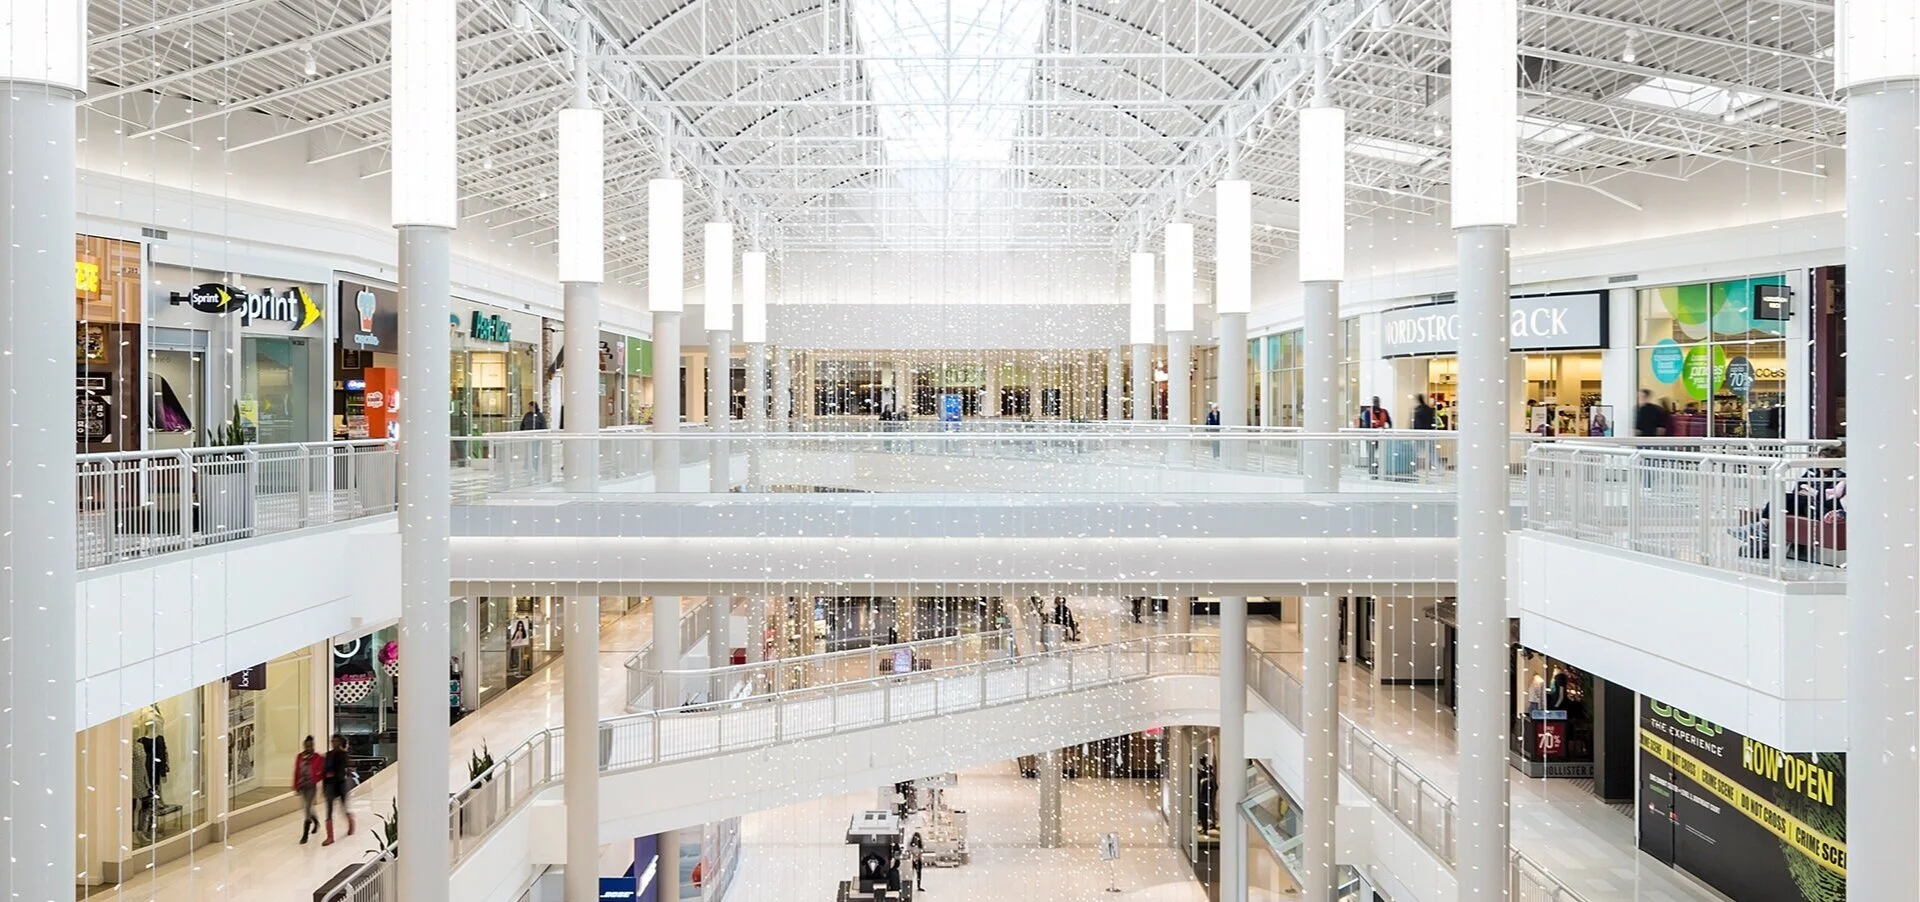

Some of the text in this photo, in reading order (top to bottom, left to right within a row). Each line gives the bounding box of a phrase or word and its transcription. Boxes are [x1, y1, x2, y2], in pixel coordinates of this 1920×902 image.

[193, 293, 219, 305] Sprint
[1651, 718, 1724, 758] THE EXPERIENCE
[1784, 753, 1834, 807] OPEN
[1702, 769, 1717, 791] CRIME
[1717, 778, 1734, 802] SCENE
[1741, 792, 1750, 811] DO
[1750, 798, 1763, 820] NOT
[1763, 806, 1786, 834] CROSS
[1795, 826, 1820, 857] CRIME
